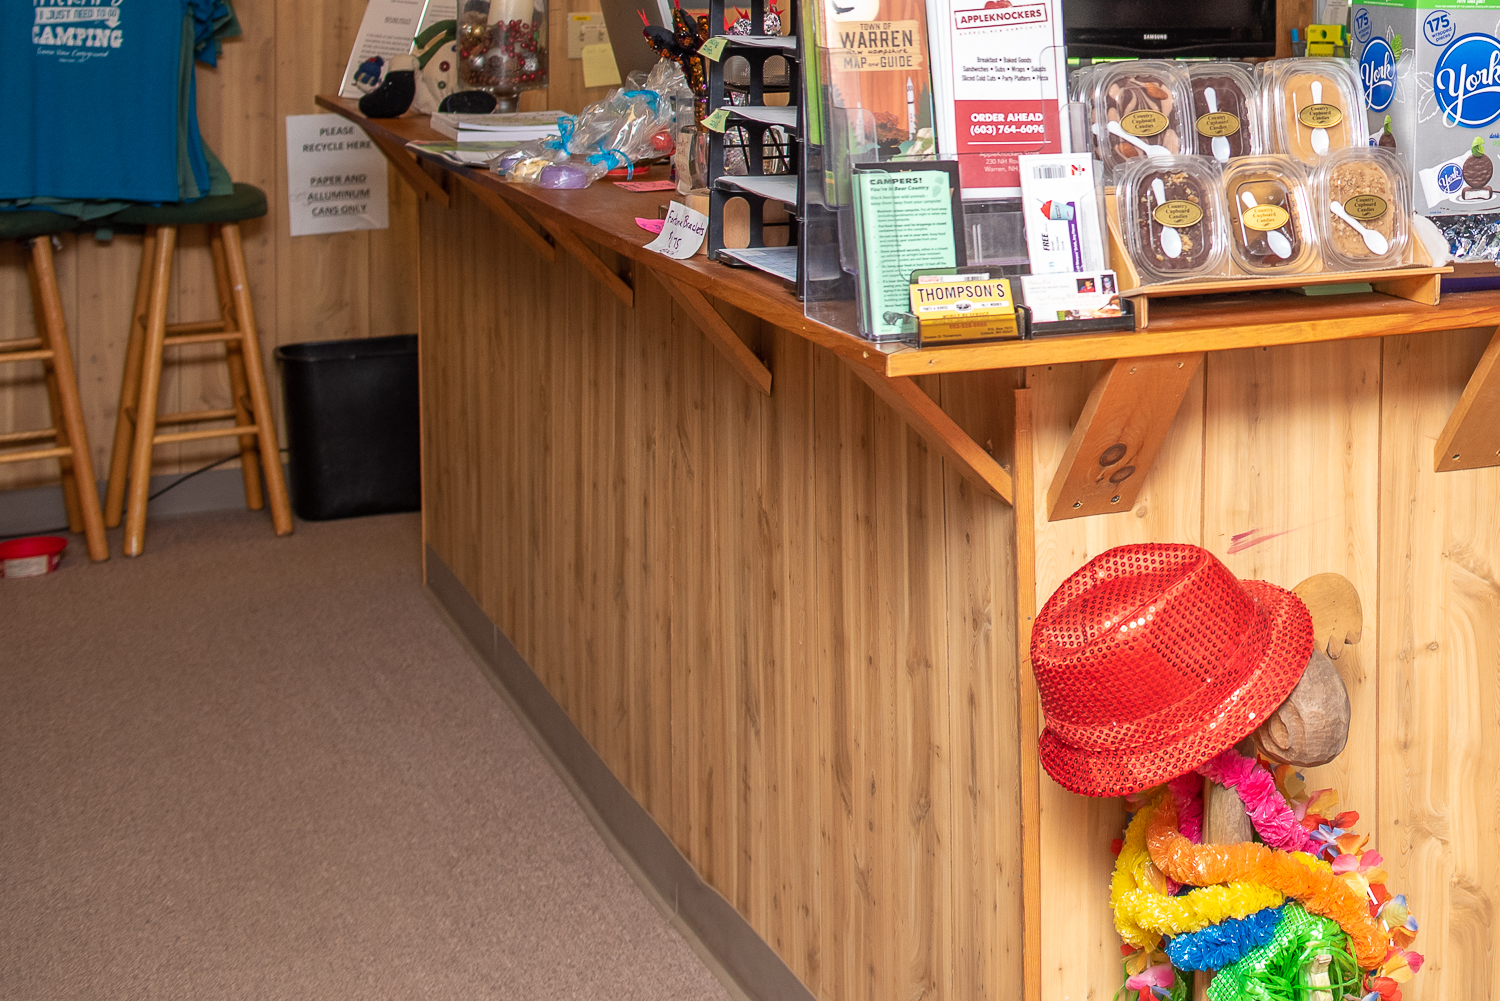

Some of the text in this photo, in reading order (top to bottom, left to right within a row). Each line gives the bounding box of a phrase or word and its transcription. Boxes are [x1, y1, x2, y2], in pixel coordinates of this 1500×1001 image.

[960, 9, 1042, 24] APPLEKNOCKERS
[1426, 14, 1450, 33] 175
[32, 26, 123, 48] CAMPING
[840, 30, 913, 48] WARREN
[1436, 34, 1451, 42] pieces
[843, 56, 912, 69] MAP GUIDE
[1361, 52, 1396, 109] York
[970, 113, 1044, 122] ORDER AHEAD
[320, 126, 354, 136] PLEASE
[970, 124, 1044, 136] (603) 764-6096
[302, 140, 371, 152] RECYCLE HERE
[310, 174, 366, 186] PAPER AND
[307, 189, 370, 202] ALLUMINUM
[312, 203, 367, 217] CANS ONLY
[917, 284, 1005, 302] THOMPSON'S
